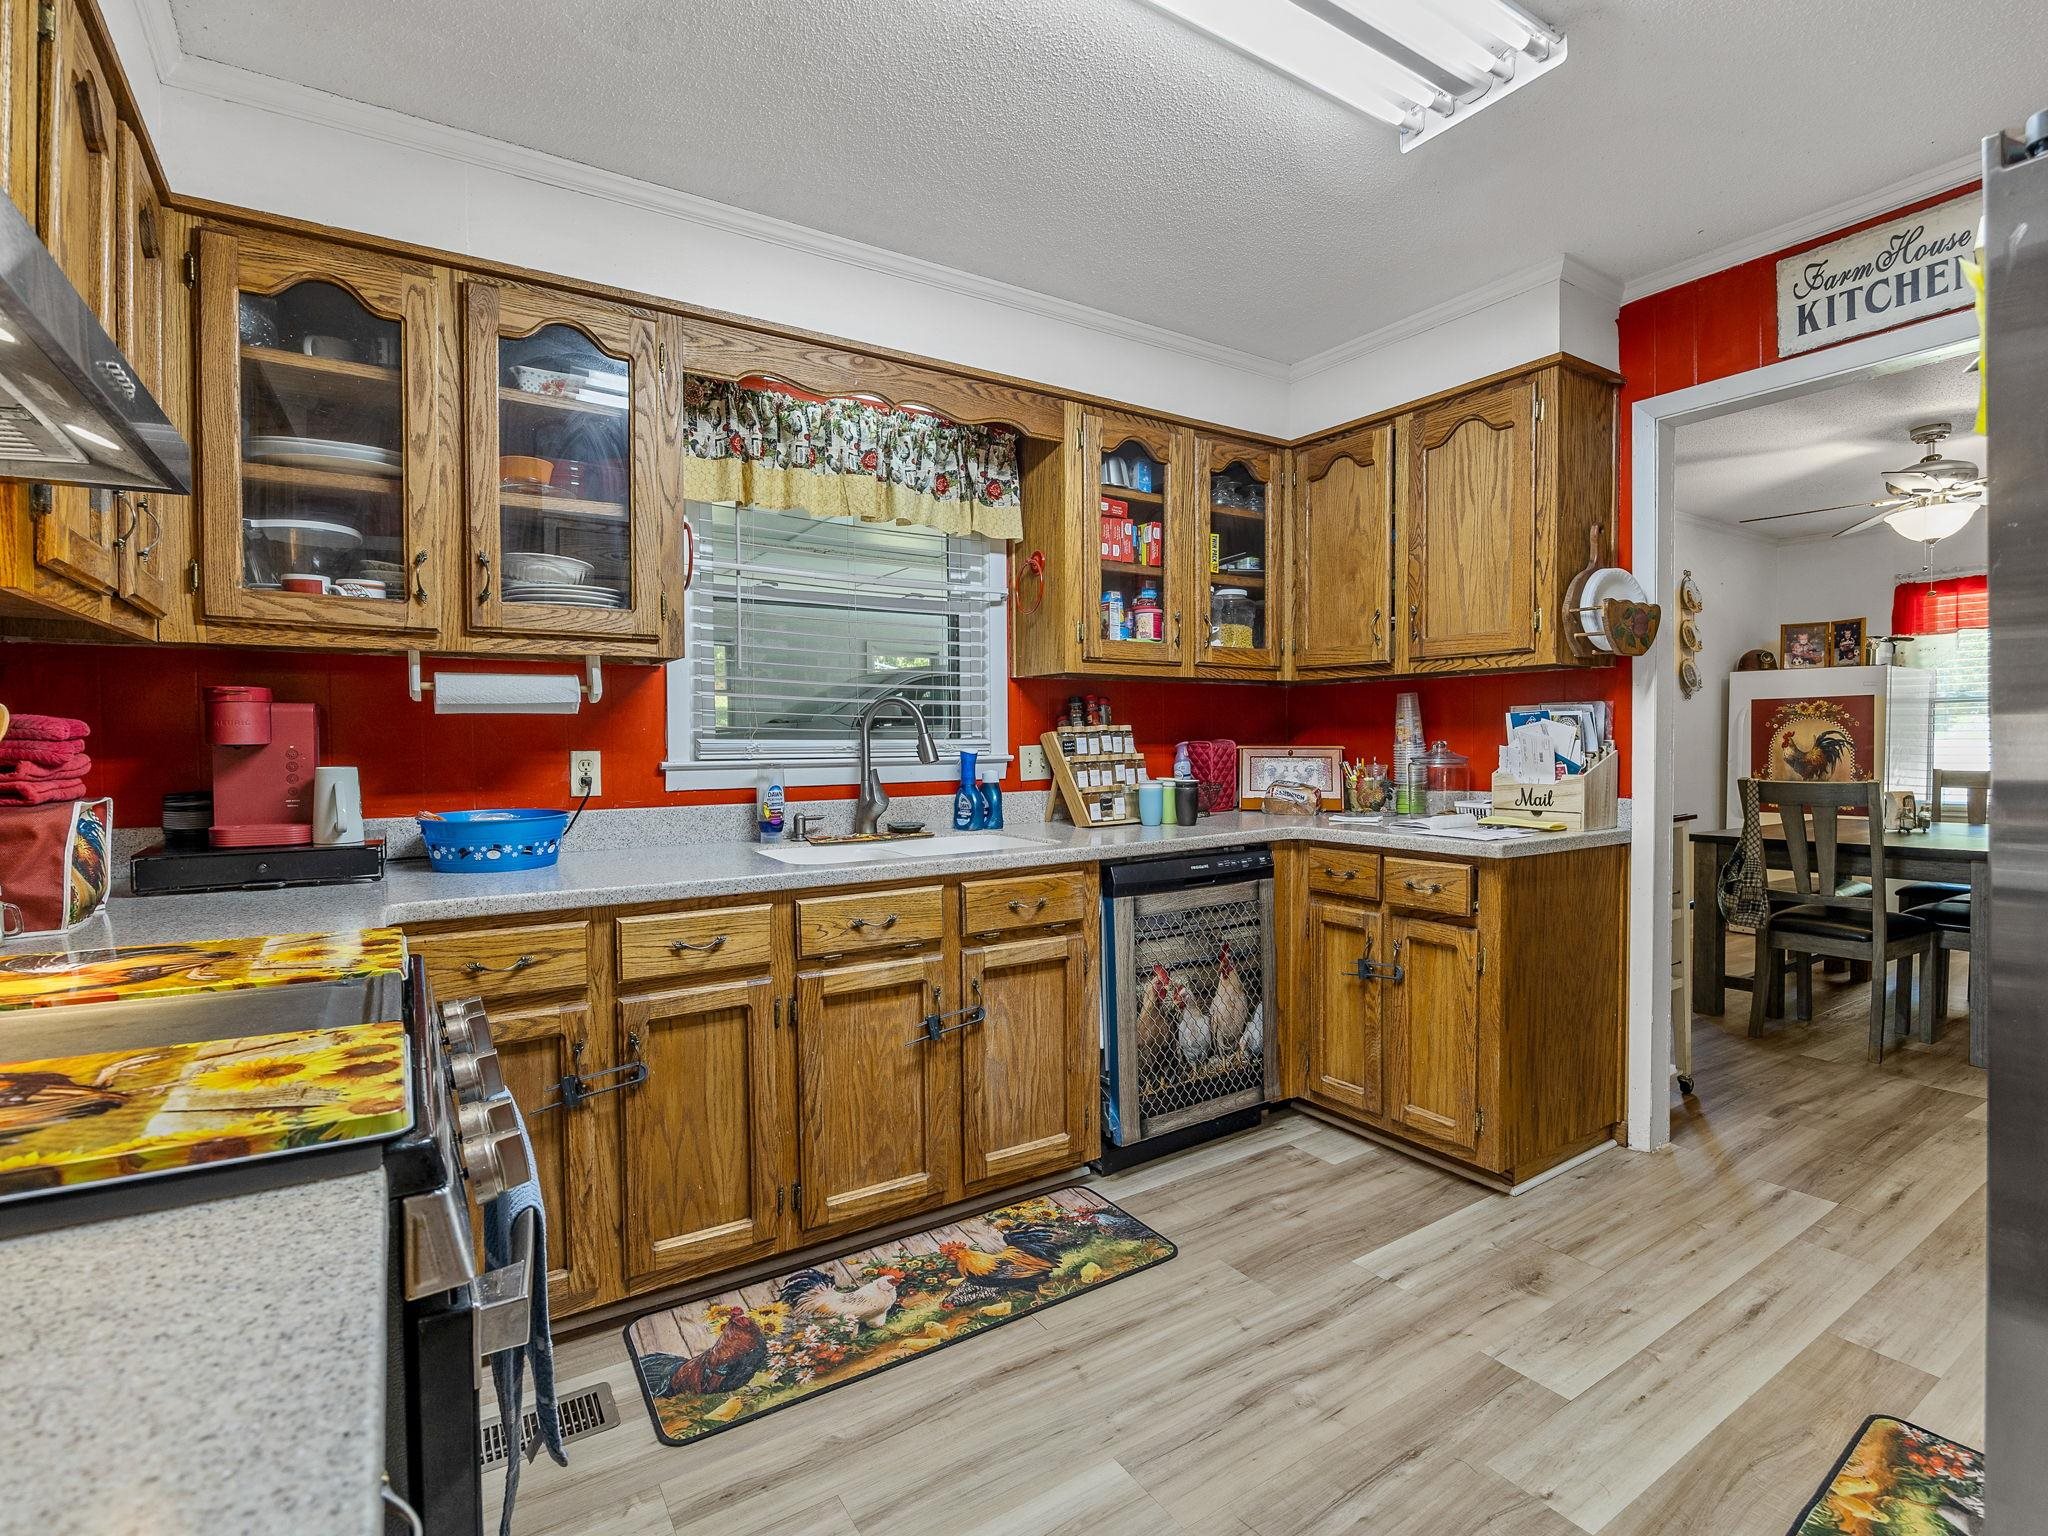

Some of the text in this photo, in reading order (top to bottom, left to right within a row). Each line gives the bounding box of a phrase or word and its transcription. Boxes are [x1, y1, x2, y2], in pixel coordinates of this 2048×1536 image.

[1793, 225, 1972, 300] Farm House
[1514, 787, 1554, 807] Mail
